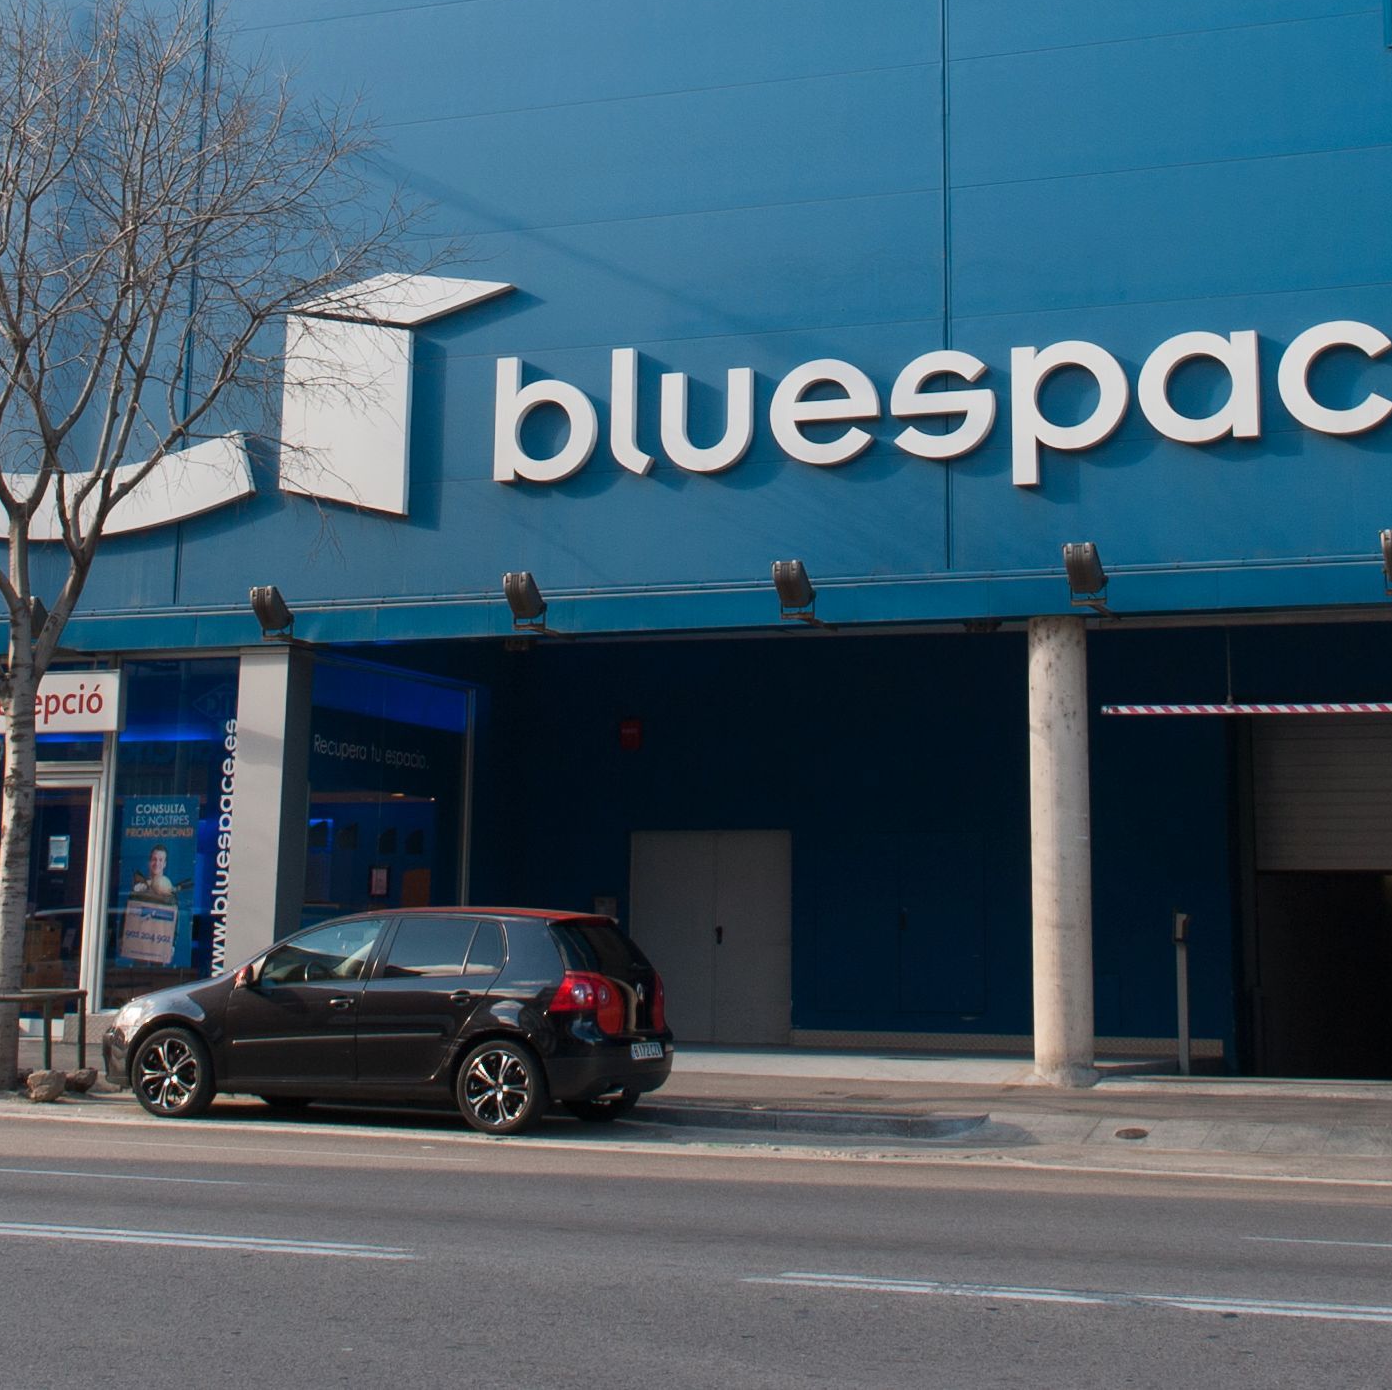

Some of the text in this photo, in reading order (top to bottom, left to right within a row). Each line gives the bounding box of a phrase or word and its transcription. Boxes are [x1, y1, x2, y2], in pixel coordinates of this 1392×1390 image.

[313, 734, 367, 760] Recupera
[371, 742, 382, 762] tu
[135, 803, 186, 814] CONSULTA
[131, 814, 190, 826] LES NOSTRES
